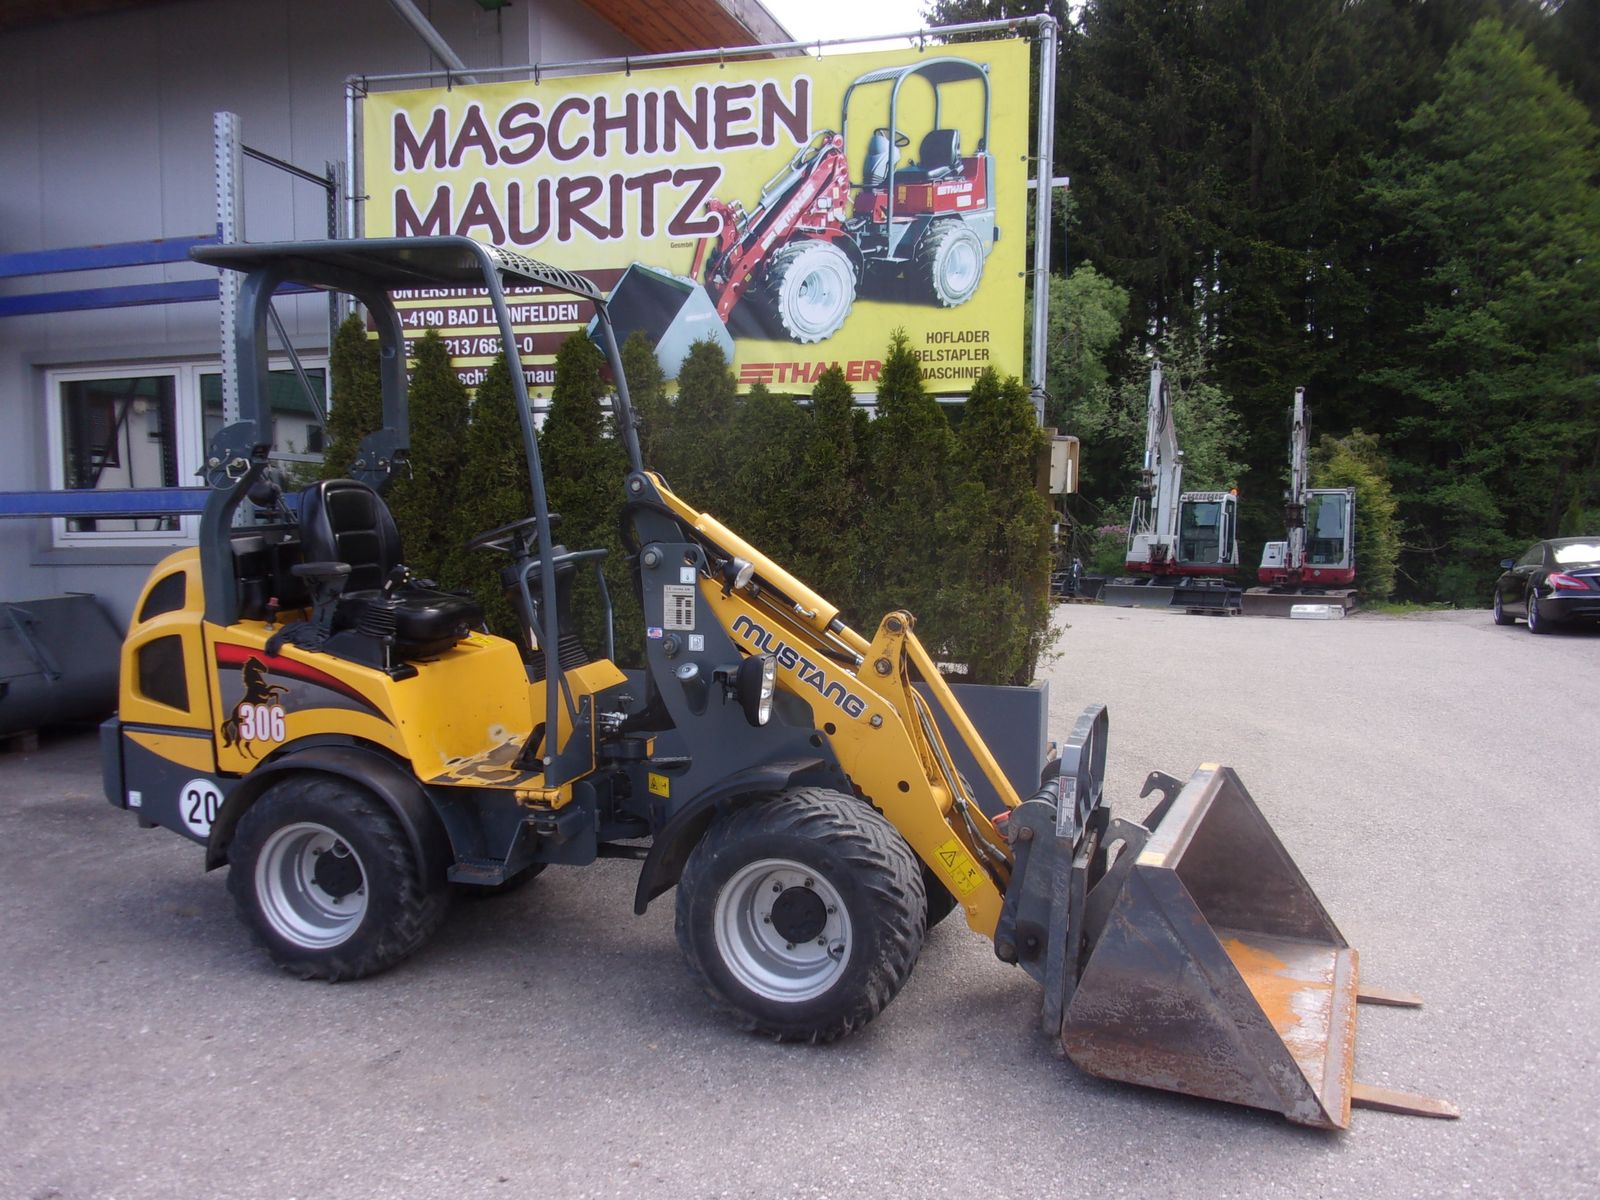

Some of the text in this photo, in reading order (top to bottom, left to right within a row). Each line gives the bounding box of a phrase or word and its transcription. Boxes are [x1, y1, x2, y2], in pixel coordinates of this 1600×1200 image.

[395, 79, 809, 172] MASCHINEN
[396, 166, 722, 246] MAURITZ
[448, 308, 479, 325] BAD
[483, 303, 579, 324] LENFELDEN
[912, 348, 990, 362] BELSTAPLER
[926, 331, 990, 344] HOFLADER
[918, 366, 993, 380] MASCHINEN
[732, 615, 865, 719] MUSTANG
[239, 703, 286, 743] 306
[187, 789, 219, 825] 20
